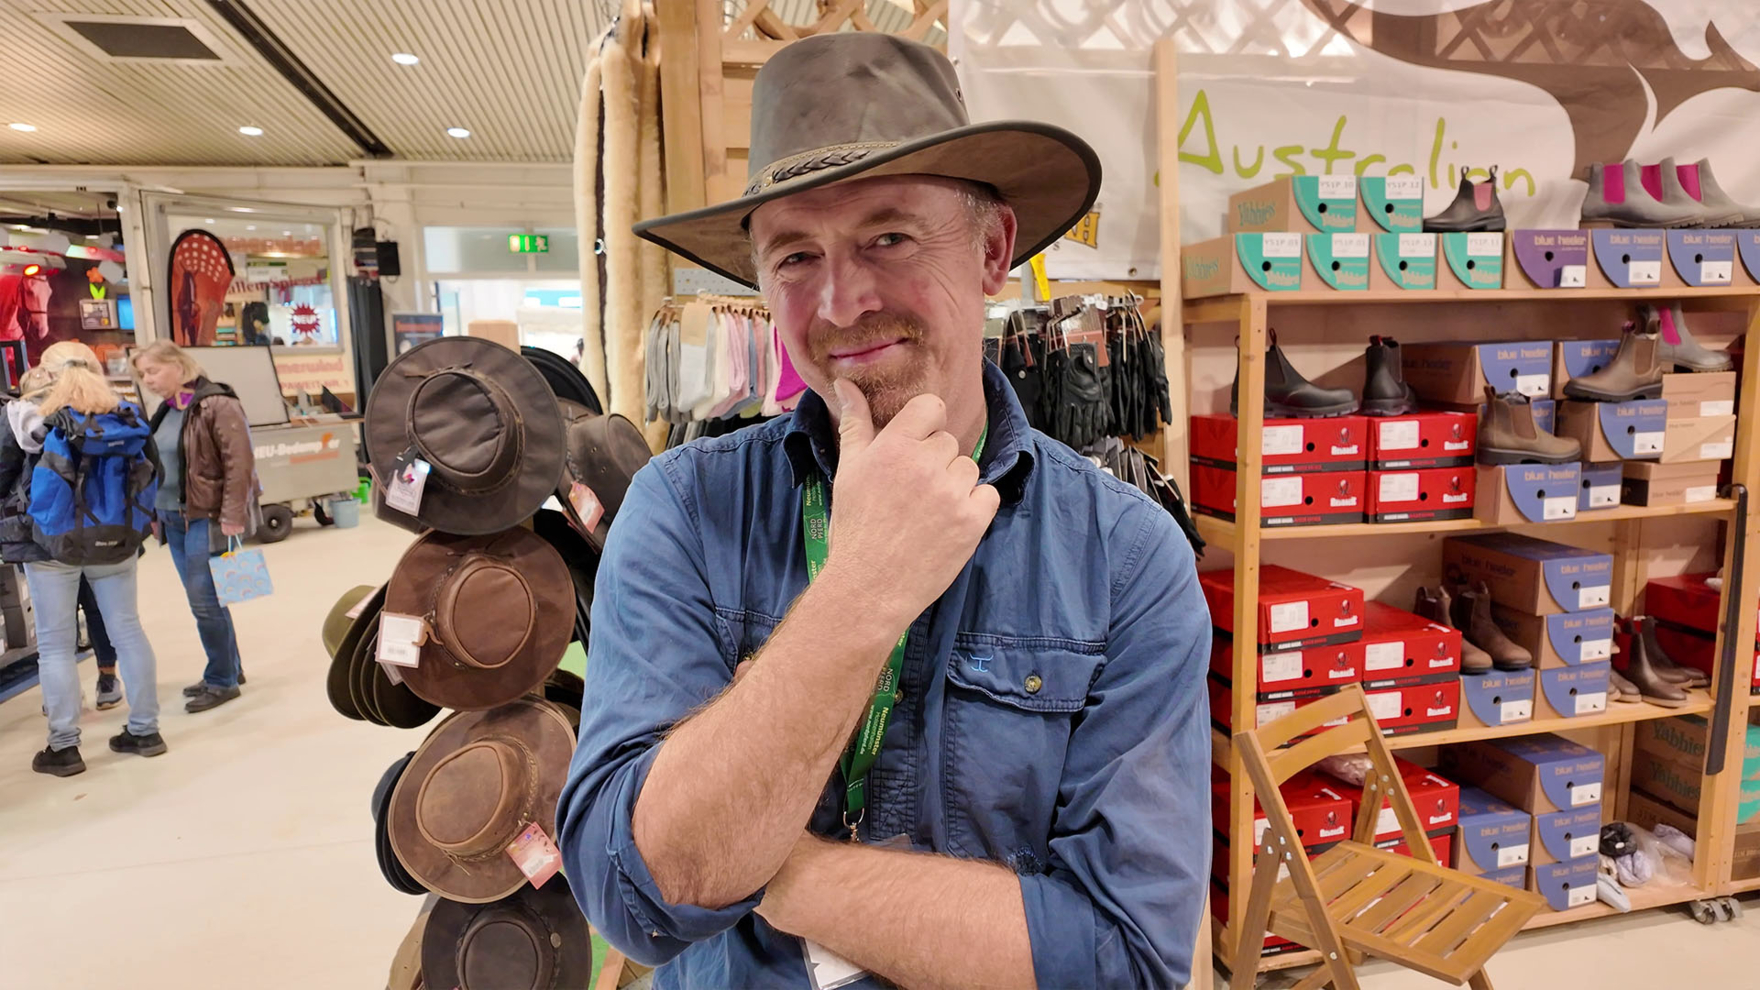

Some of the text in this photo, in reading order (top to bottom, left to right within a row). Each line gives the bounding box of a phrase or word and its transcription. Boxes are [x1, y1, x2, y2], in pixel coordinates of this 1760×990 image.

[1534, 234, 1555, 246] blue
[1610, 234, 1630, 245] blue
[1683, 234, 1702, 244] blue
[1497, 349, 1518, 360] blue
[1616, 406, 1635, 416] blue
[1524, 471, 1545, 482] blue
[1561, 564, 1580, 574] blue
[1564, 618, 1582, 629] blue
[882, 668, 893, 692] NORD
[1482, 679, 1502, 689] blue
[871, 706, 889, 756] Neumünster
